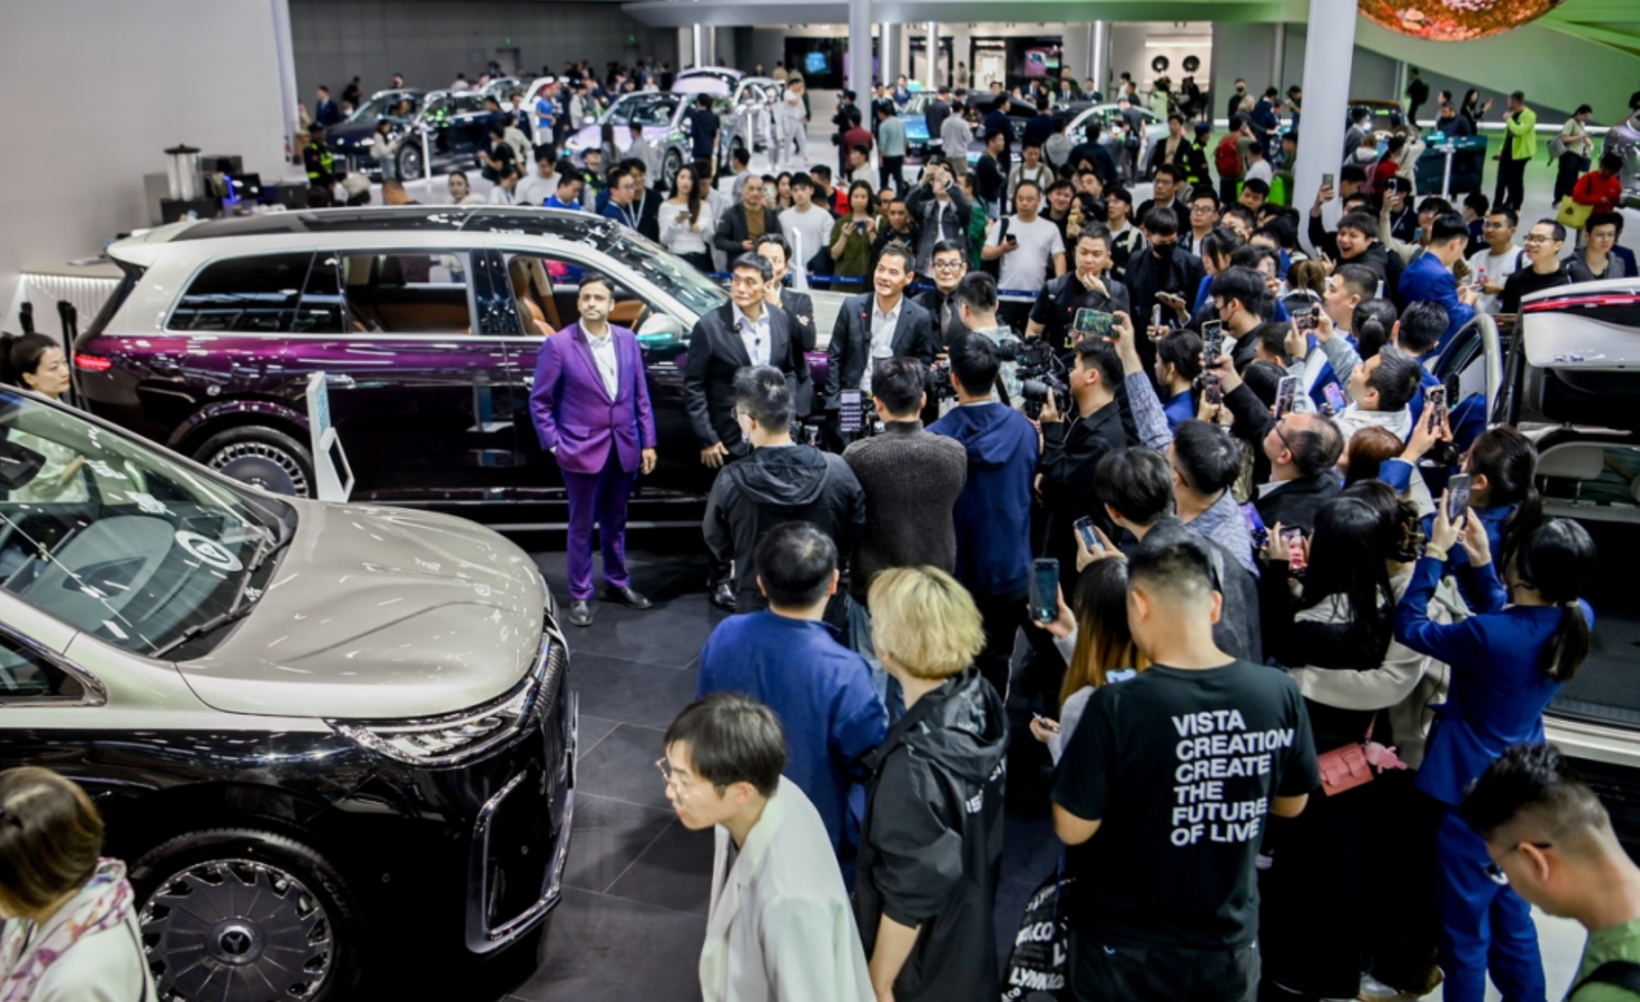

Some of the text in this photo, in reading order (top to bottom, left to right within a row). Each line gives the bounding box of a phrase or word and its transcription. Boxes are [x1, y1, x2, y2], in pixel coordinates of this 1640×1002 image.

[1171, 709, 1246, 737] VISTA
[1175, 728, 1294, 761] CREATION
[1174, 753, 1271, 783] CREATE
[1173, 780, 1224, 805] THE
[1172, 797, 1268, 826] FUTURE
[1170, 817, 1260, 846] OF LIVE
